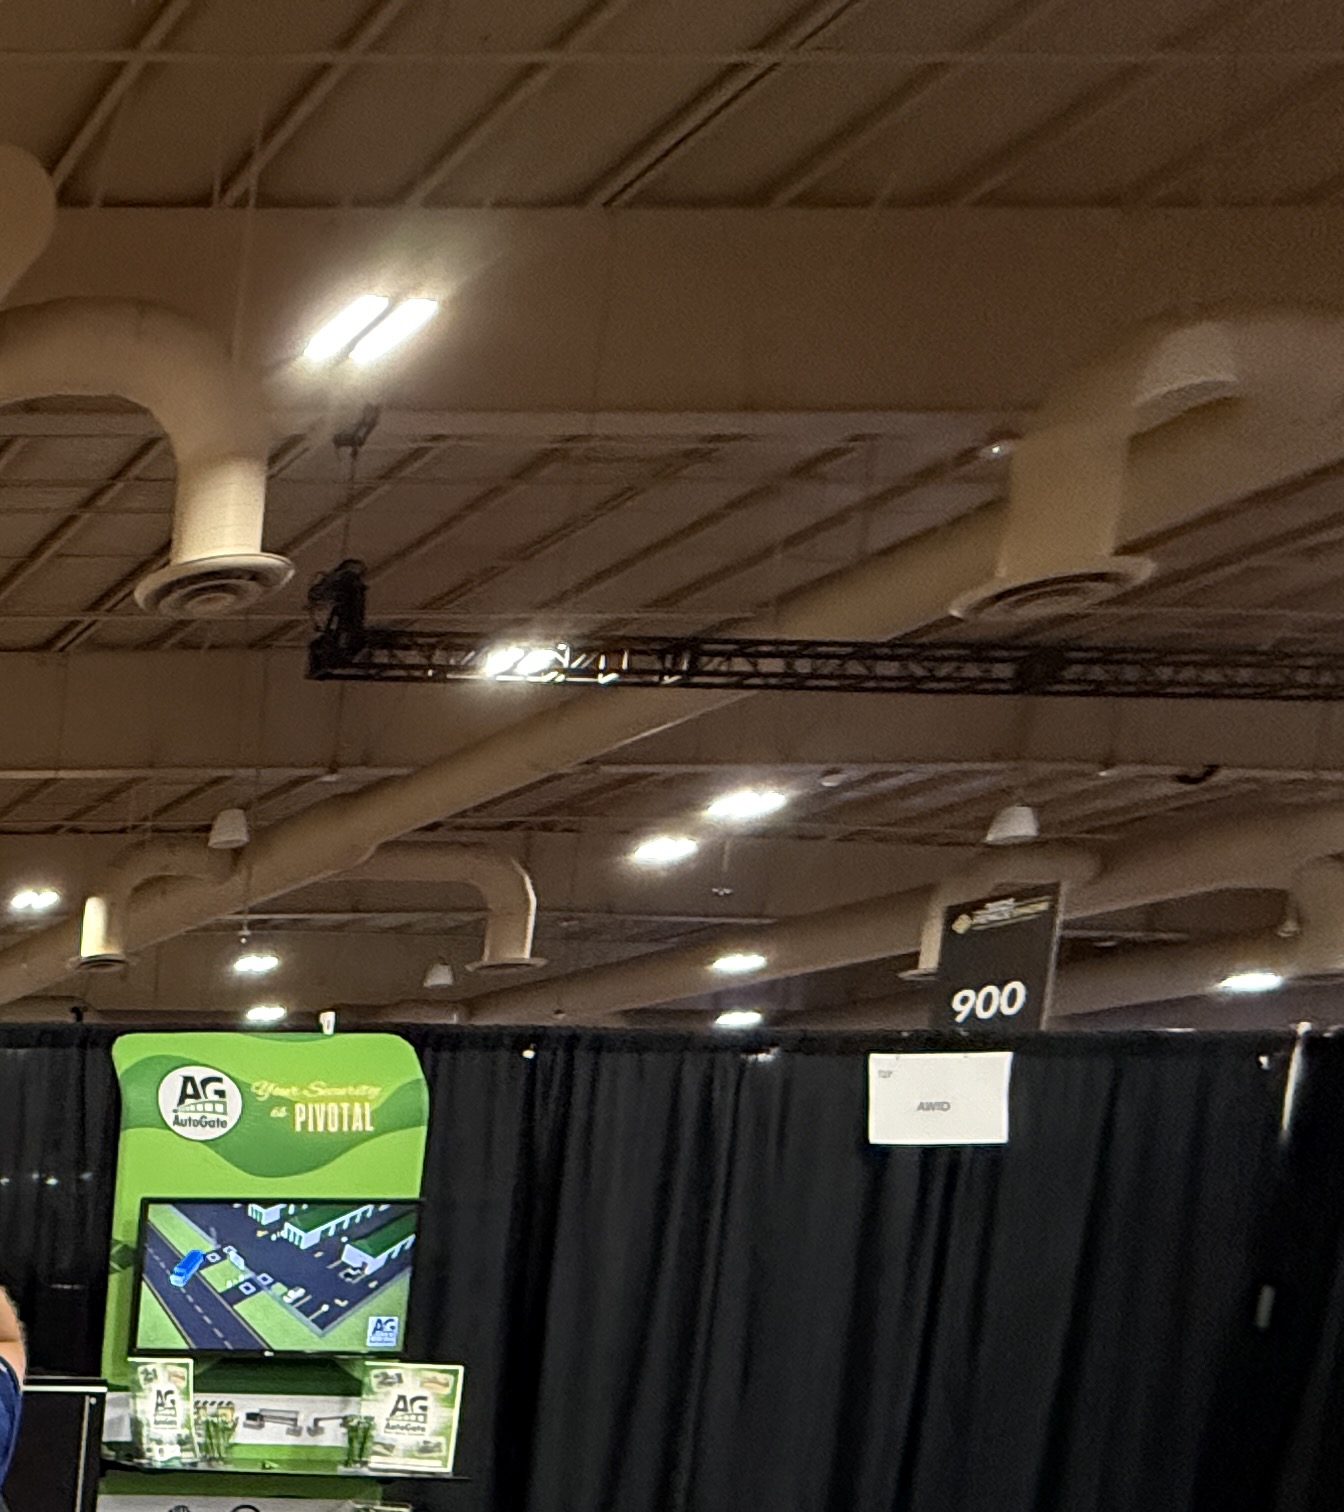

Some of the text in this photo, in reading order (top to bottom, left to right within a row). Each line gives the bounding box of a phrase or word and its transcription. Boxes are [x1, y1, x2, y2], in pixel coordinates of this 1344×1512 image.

[951, 980, 1026, 1023] 900
[177, 1075, 227, 1107] AG
[172, 1115, 228, 1129] AutoGate
[294, 1102, 374, 1133] PIVOTAL
[372, 1318, 397, 1336] AG
[389, 1395, 428, 1418] AG
[385, 1422, 426, 1433] AutoGate
